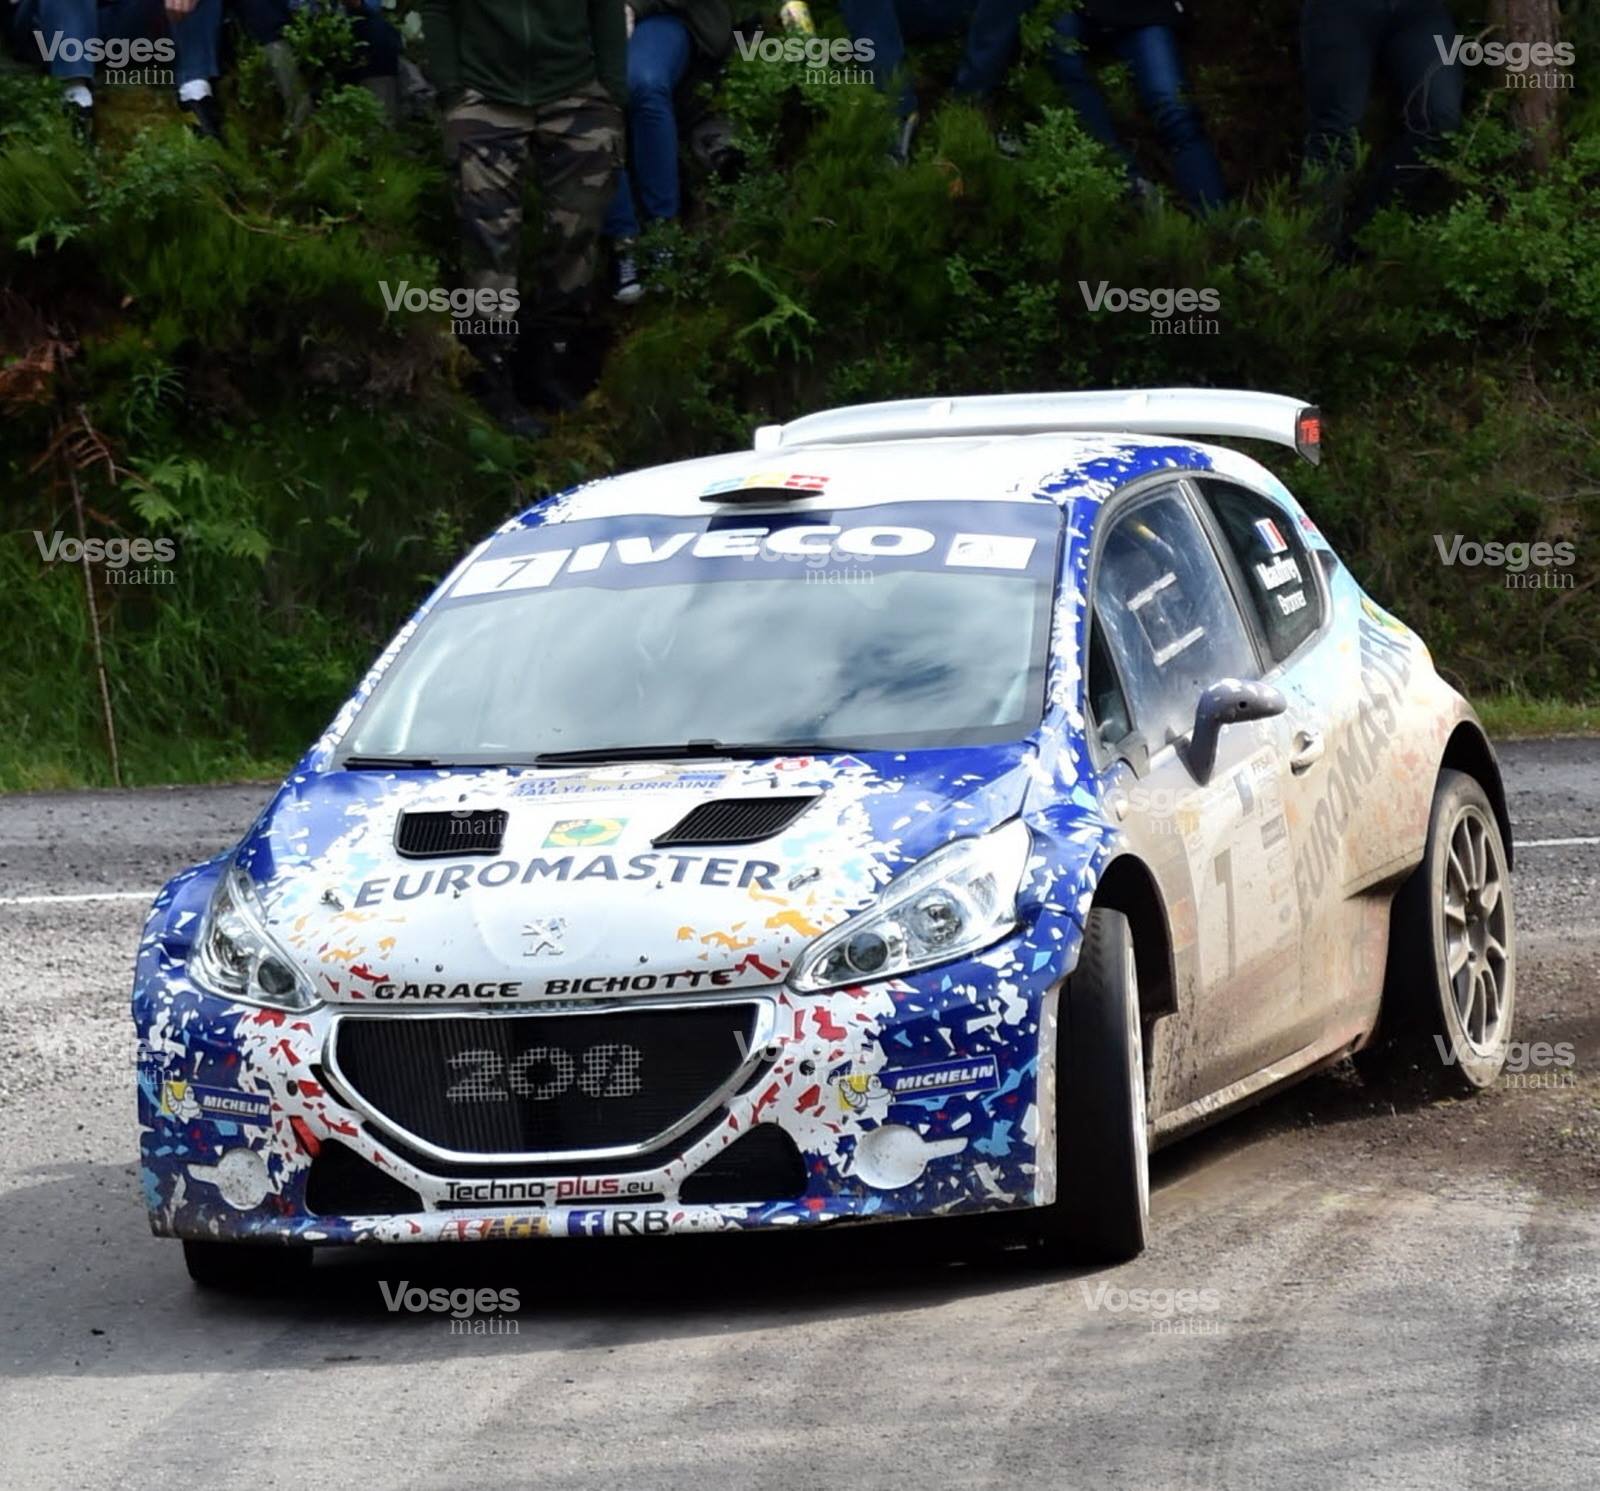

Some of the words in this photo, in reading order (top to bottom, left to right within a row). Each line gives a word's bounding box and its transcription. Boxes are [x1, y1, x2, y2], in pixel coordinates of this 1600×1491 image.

[567, 525, 936, 573] IVECO
[617, 779, 722, 792] LORRAINE
[353, 853, 781, 908] EUROMASTER
[374, 981, 522, 1000] GARAGE
[545, 968, 736, 996] BICHOTTE
[895, 1064, 994, 1091] MICHELIN
[203, 1095, 271, 1116] MICHELIN
[445, 1176, 654, 1202] Techno-plus.eu
[612, 1209, 671, 1235] RB
